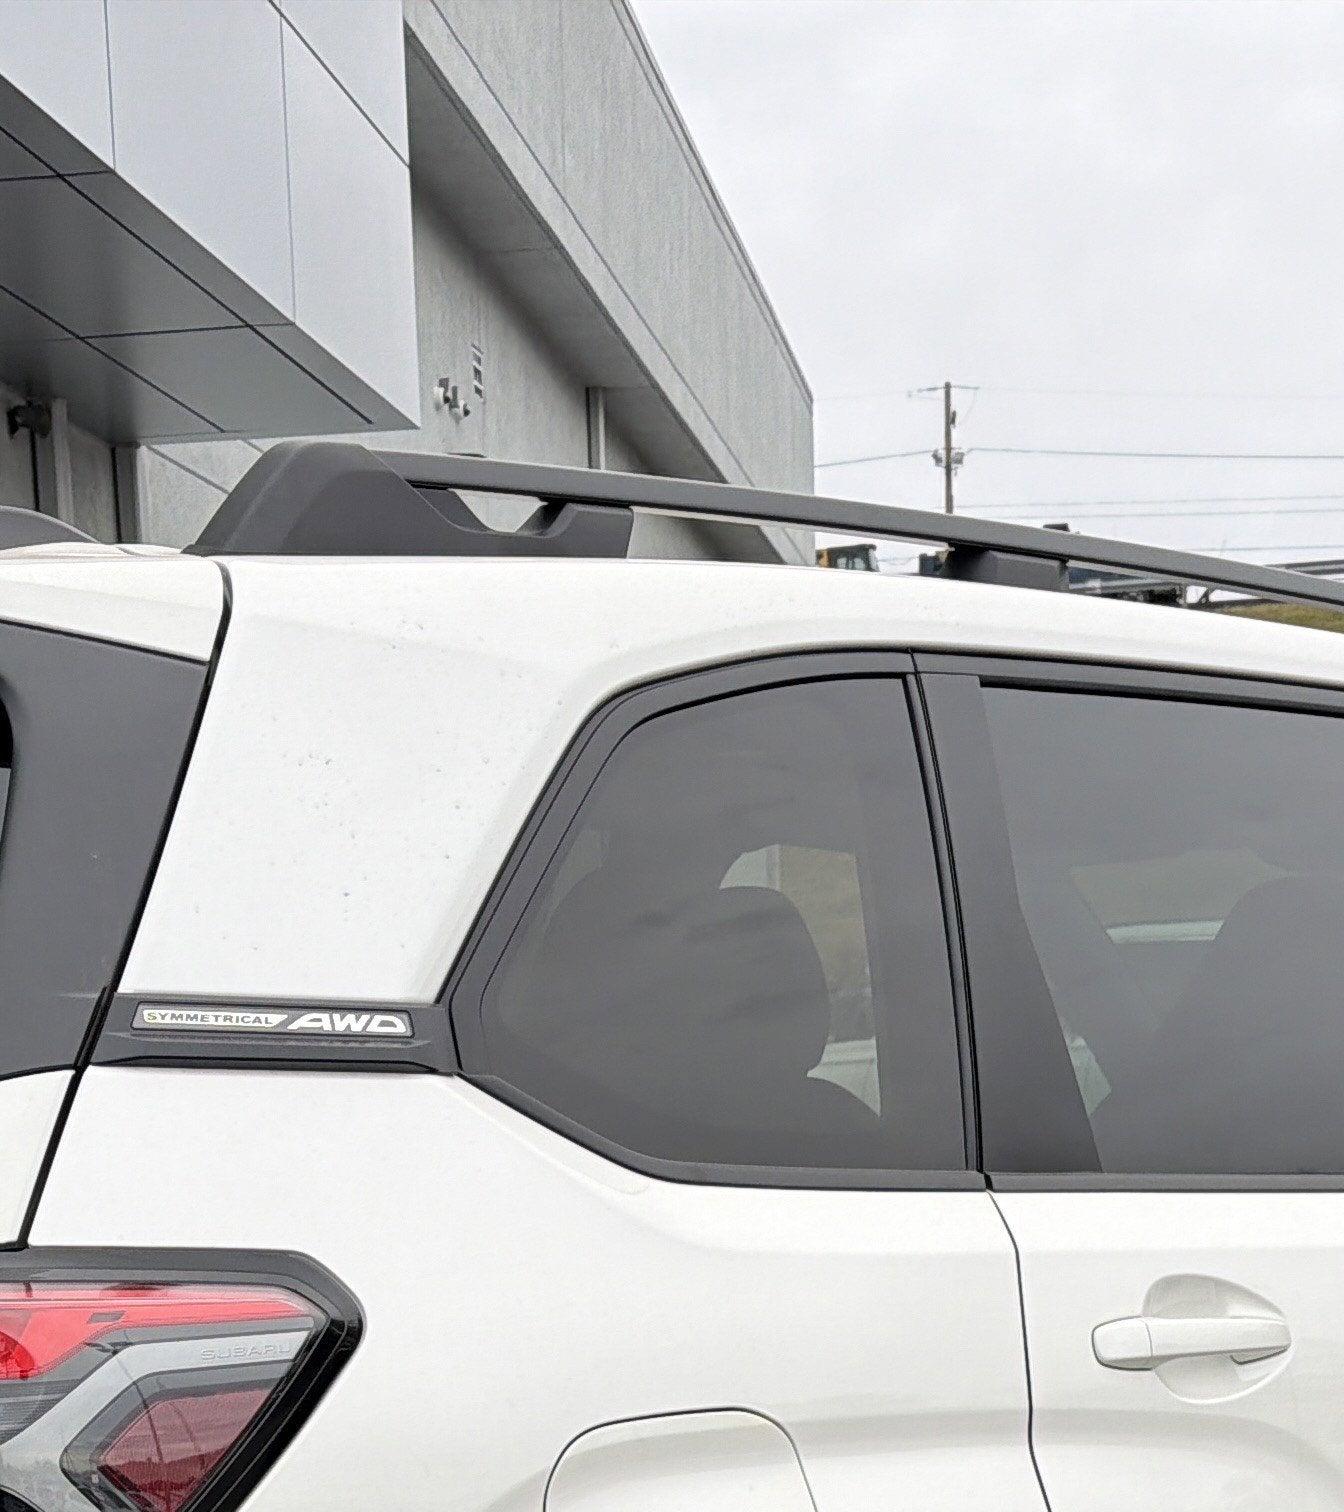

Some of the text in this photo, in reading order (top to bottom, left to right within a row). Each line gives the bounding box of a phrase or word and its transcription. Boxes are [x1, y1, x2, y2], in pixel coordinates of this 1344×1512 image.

[145, 1010, 407, 1033] SYMMETRICAL AWD
[200, 1344, 291, 1361] SUBARU
